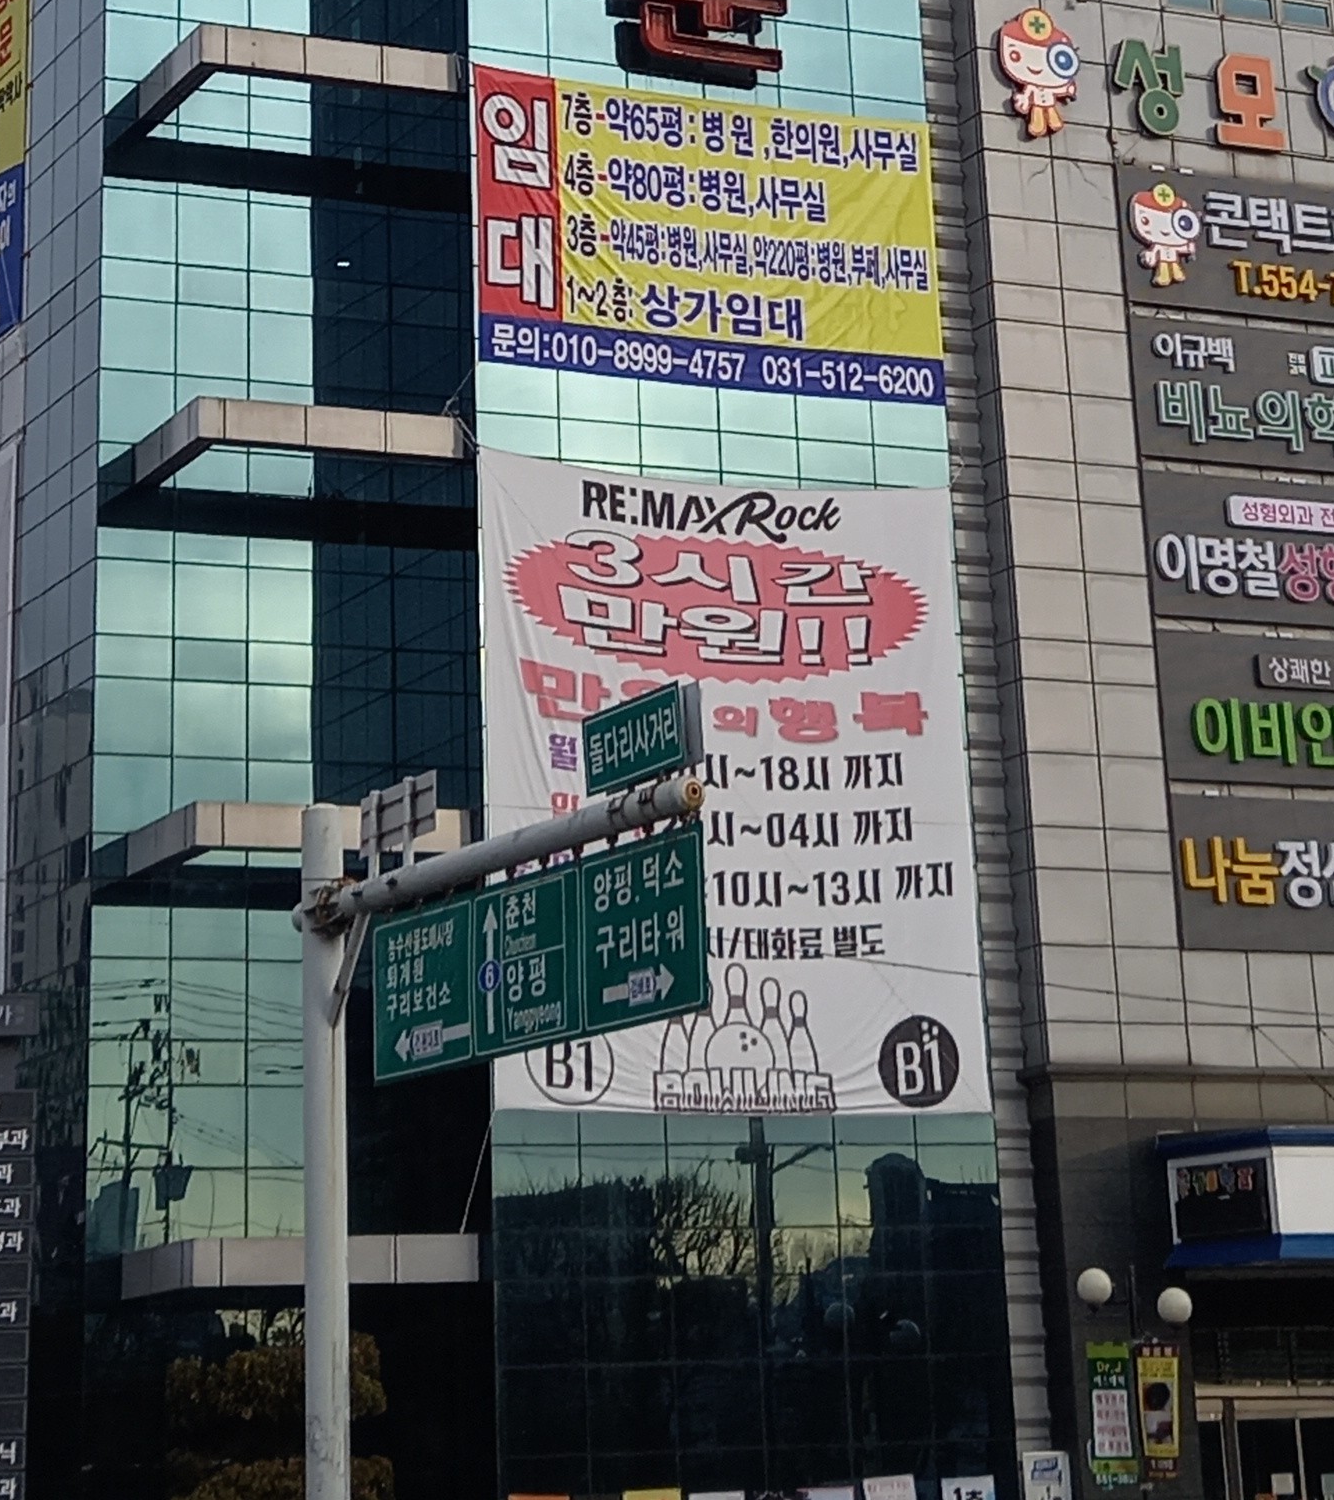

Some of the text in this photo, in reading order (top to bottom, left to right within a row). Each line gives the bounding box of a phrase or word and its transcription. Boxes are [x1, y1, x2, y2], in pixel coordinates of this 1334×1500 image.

[480, 91, 558, 310] 임대
[641, 284, 805, 341] 상가임대
[1153, 333, 1235, 373] 이규백
[762, 355, 935, 398] 031-512-6200
[1242, 501, 1313, 527] 성형외과
[566, 530, 876, 606] 3시간
[1268, 657, 1331, 688] 상쾌한
[588, 702, 679, 776] 돌다리사거리
[844, 752, 904, 789] 까지
[854, 808, 914, 844] 까지
[643, 850, 685, 898] 덕소
[895, 862, 955, 900] 까지
[505, 890, 537, 930] 춘천
[596, 907, 686, 968] 구리타워
[833, 923, 885, 959] 별도
[387, 957, 424, 988] 퇴계원
[484, 964, 495, 988] 6
[506, 956, 547, 1002] 양평
[387, 984, 452, 1021] 구리보건소
[653, 1067, 837, 1113] BOWLING
